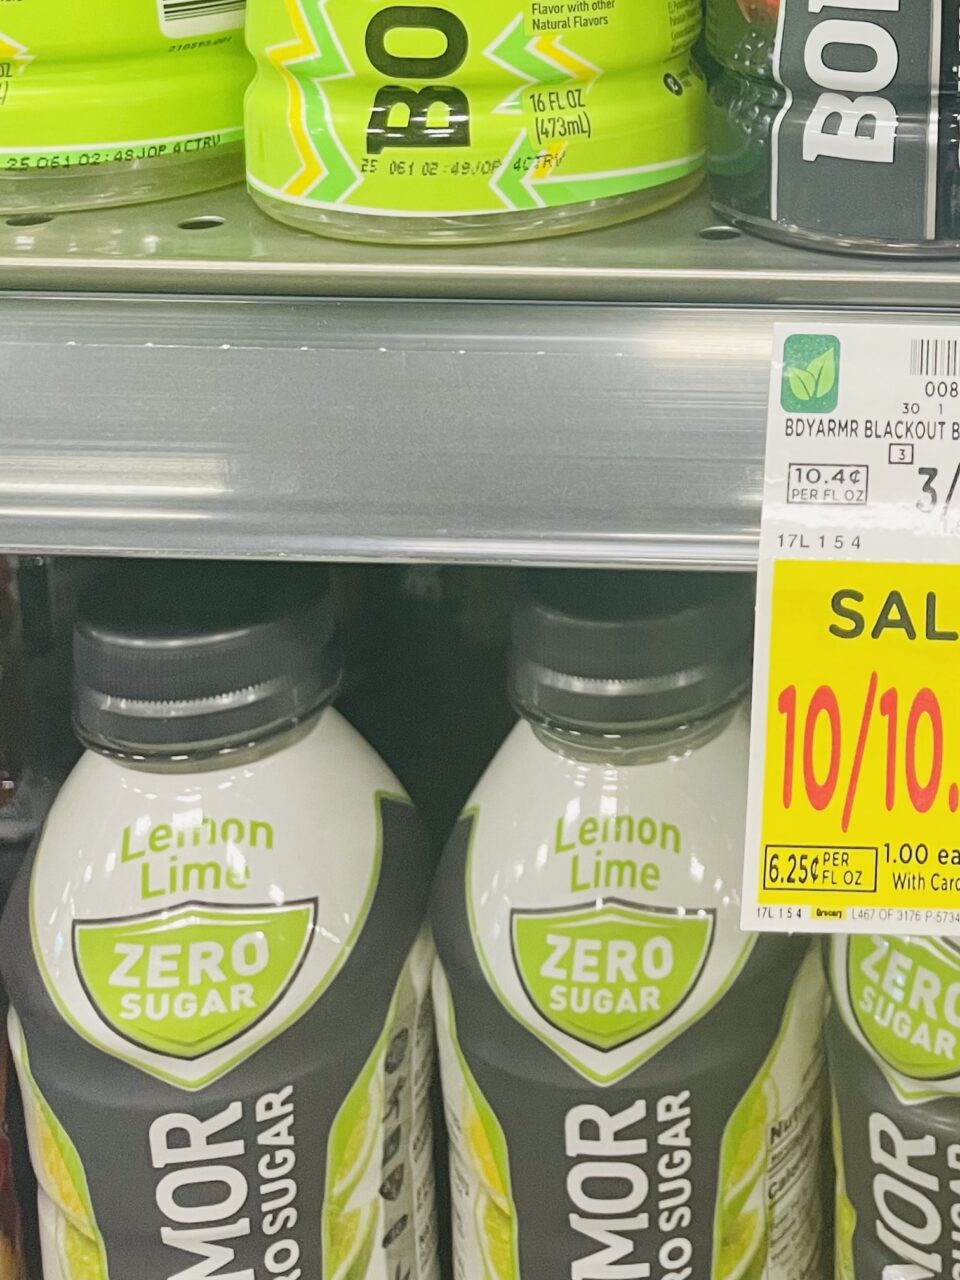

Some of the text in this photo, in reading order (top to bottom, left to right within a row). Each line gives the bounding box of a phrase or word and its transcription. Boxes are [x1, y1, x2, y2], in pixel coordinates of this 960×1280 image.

[532, 0, 615, 15] Flavor with other
[532, 15, 608, 31] Natural Flavors
[530, 89, 585, 113] 16 FL OZ
[535, 111, 591, 144] (473mL)
[902, 403, 919, 414] 30
[785, 418, 858, 437] BDYARMR
[865, 420, 945, 440] BLACKOUT
[795, 467, 861, 485] 10.4¢
[792, 488, 864, 502] PER FL OZ
[778, 534, 810, 548] 17L
[121, 817, 274, 864] Lemon
[554, 814, 682, 855] Lemon
[769, 852, 849, 884] 6.25¢ PER
[884, 842, 928, 866] 1.00
[140, 853, 250, 900] Lime
[569, 851, 660, 894] Lime
[822, 870, 862, 885] FL OZ
[893, 872, 925, 891] With
[758, 907, 773, 919] 17L
[108, 931, 270, 988] ZERO
[539, 934, 674, 984] ZERO
[119, 983, 257, 1021] SUGAR
[549, 985, 662, 1015] SUGAR
[858, 987, 957, 1061] SUGAR
[255, 1084, 299, 1231] SUGAR
[657, 1090, 692, 1228] SUGAR
